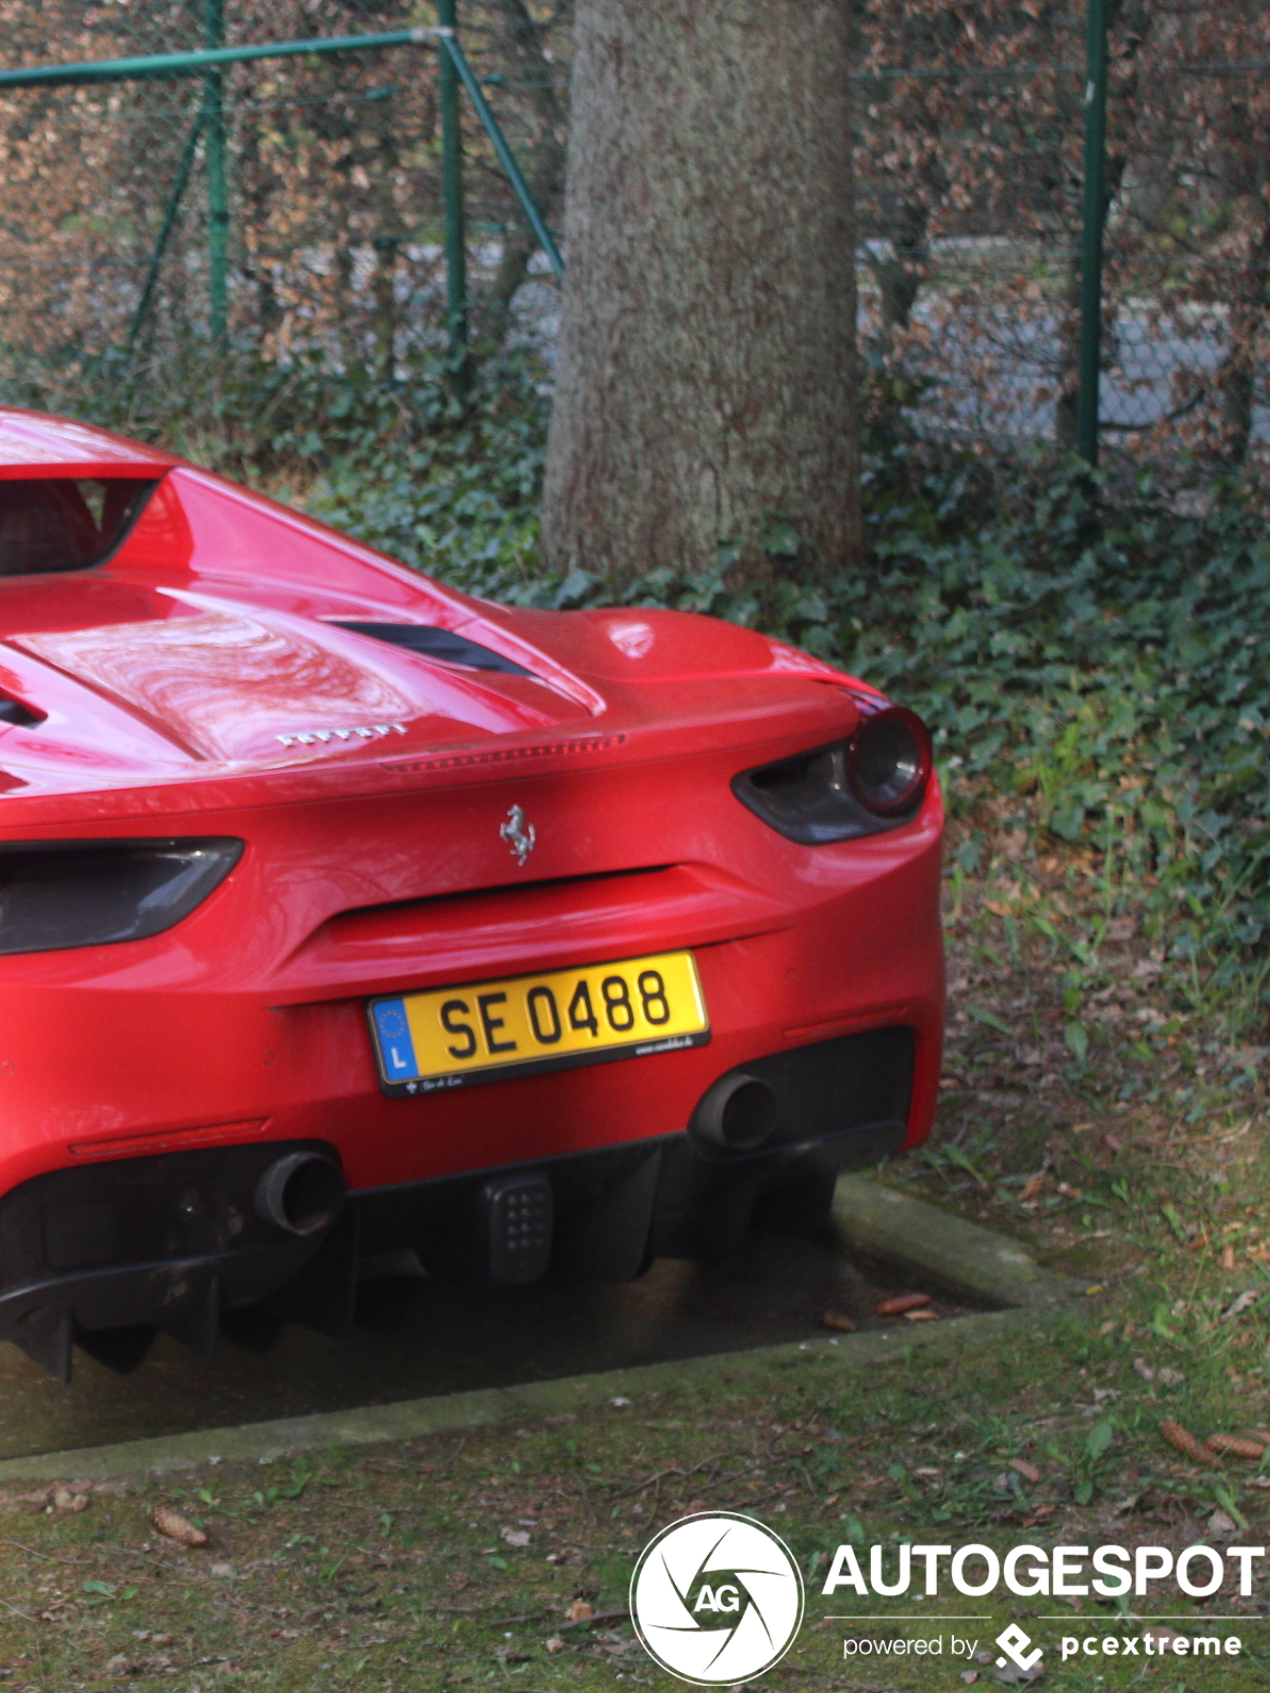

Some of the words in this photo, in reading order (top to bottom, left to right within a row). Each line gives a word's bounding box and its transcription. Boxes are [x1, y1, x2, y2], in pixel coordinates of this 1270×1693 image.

[439, 991, 518, 1060] SE
[525, 969, 671, 1046] 0488
[391, 1048, 407, 1069] L
